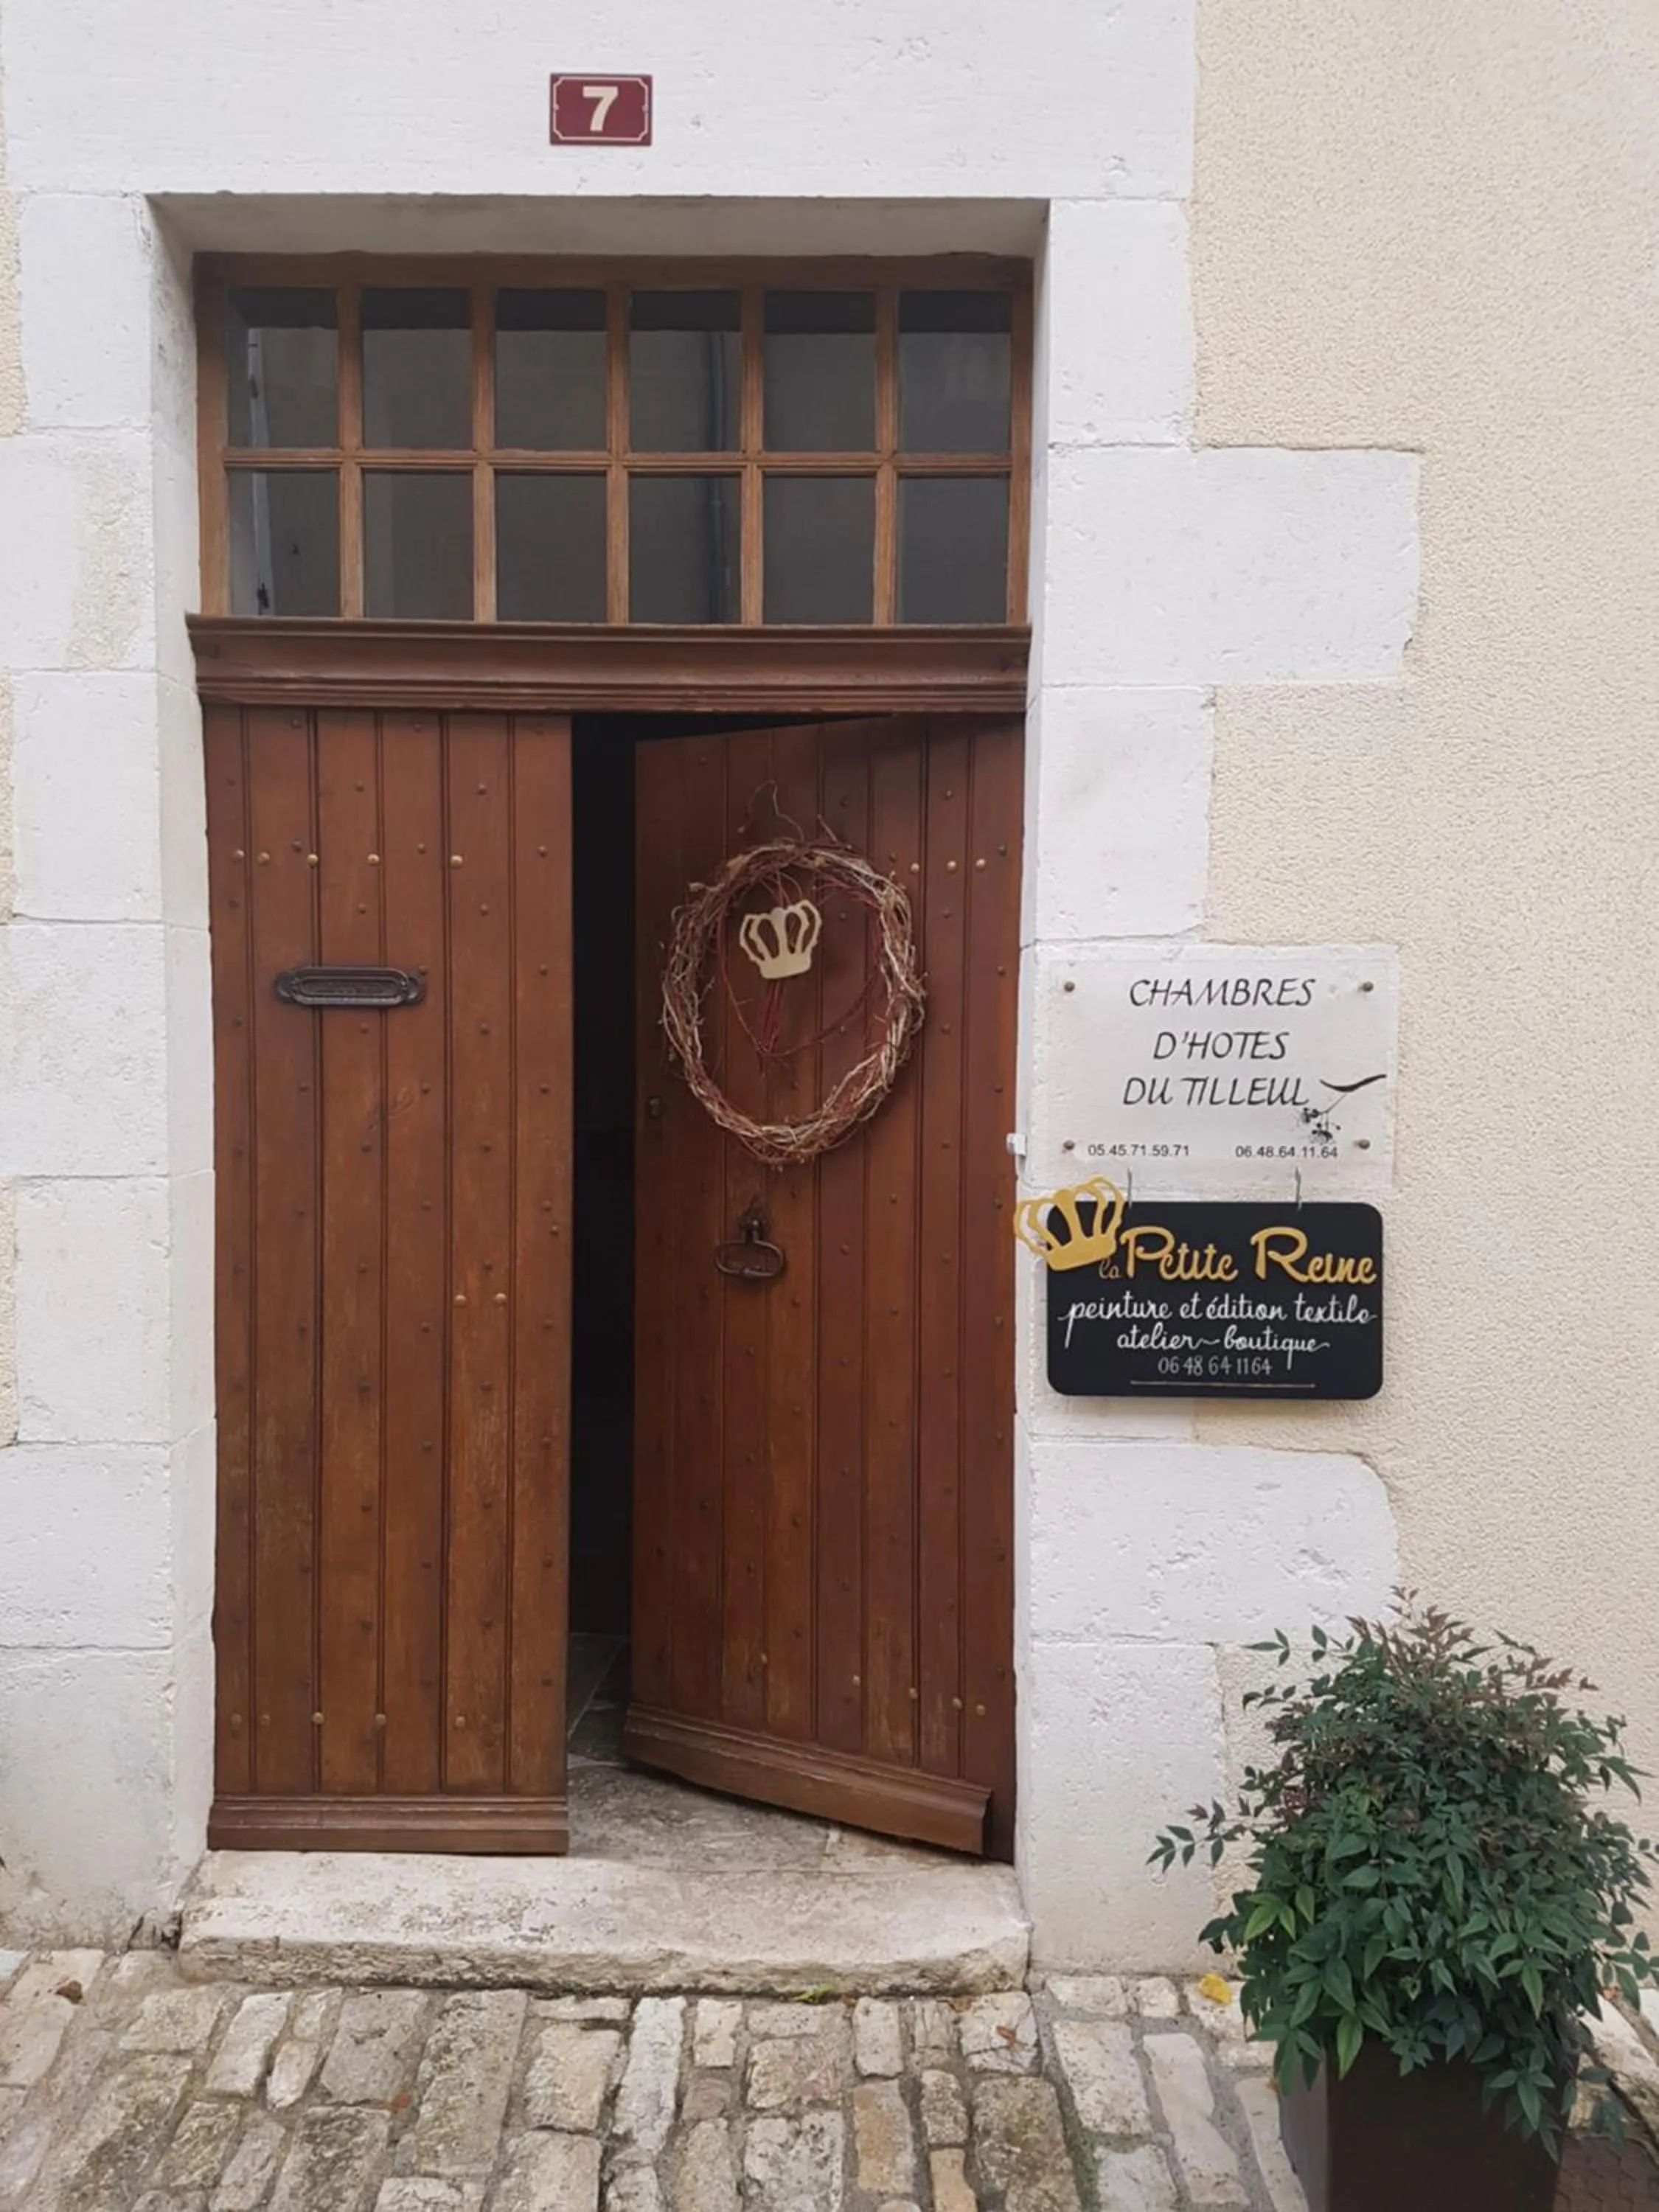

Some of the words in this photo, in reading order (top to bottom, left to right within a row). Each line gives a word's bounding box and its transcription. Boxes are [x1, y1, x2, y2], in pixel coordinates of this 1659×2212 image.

[582, 86, 619, 132] 7
[1129, 978, 1316, 1007] CHAMBRES
[1152, 1031, 1290, 1060] D'HOTES
[1123, 1077, 1174, 1105] DU
[1180, 1076, 1310, 1106] TILLEUL
[1088, 1144, 1190, 1157] 05.45.71.59.71
[1234, 1145, 1338, 1158] 06.48.64.11.64
[1119, 1225, 1239, 1281] Petite
[1250, 1226, 1377, 1284] Reine
[1057, 1290, 1173, 1349] peinture
[1180, 1292, 1203, 1321] et
[1206, 1295, 1287, 1322] édition
[1294, 1292, 1377, 1324] textile
[1158, 1356, 1180, 1374] 06
[1183, 1355, 1203, 1376] 48
[1208, 1355, 1232, 1374] 64
